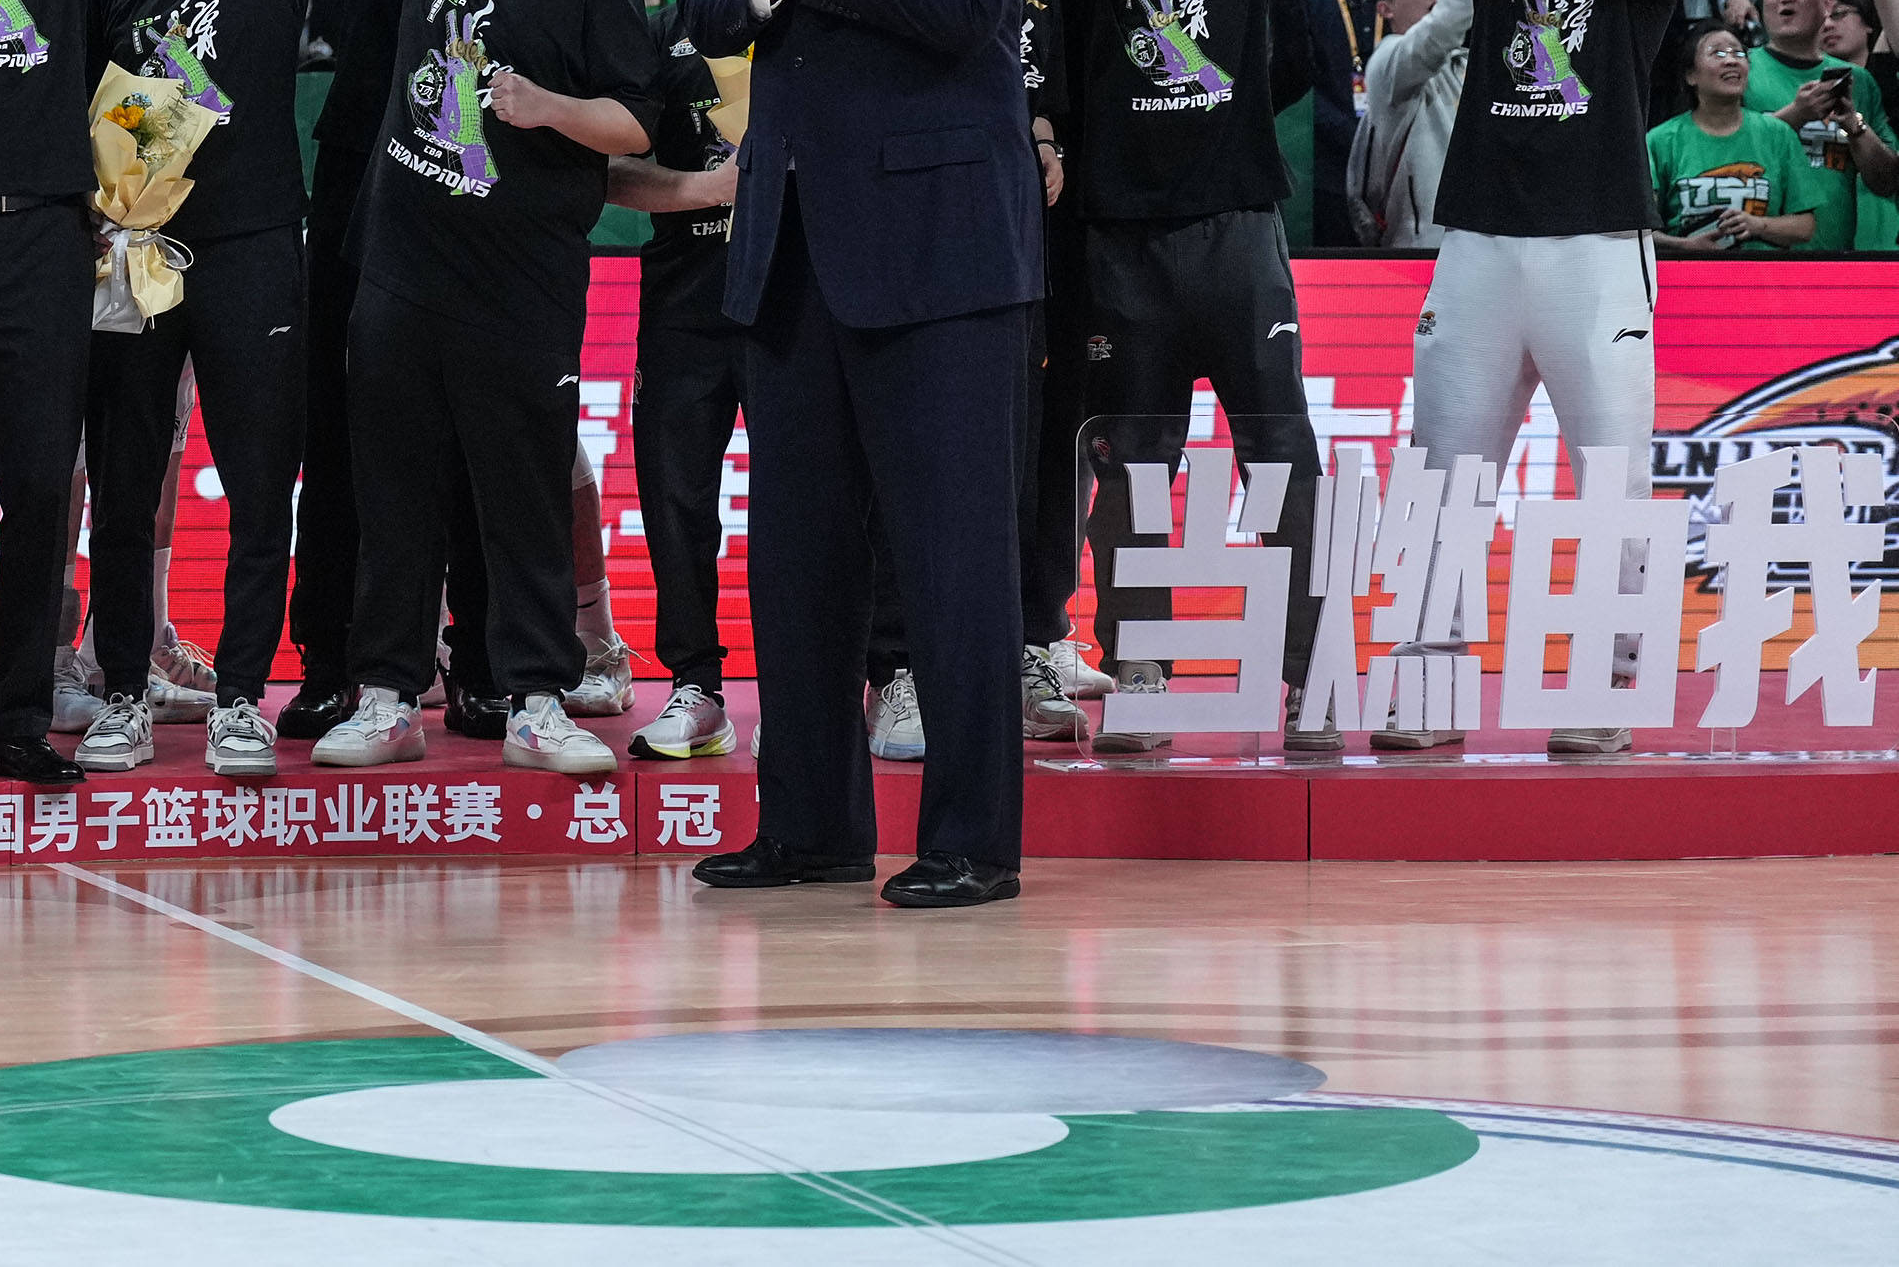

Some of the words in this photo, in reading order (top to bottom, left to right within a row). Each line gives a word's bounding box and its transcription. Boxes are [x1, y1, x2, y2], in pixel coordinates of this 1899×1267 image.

[1132, 88, 1233, 112] CHAMPIONS
[1490, 101, 1589, 118] CHAMPIONS
[387, 137, 492, 199] CHAMPIONS
[1102, 445, 1885, 732] 当燃由我
